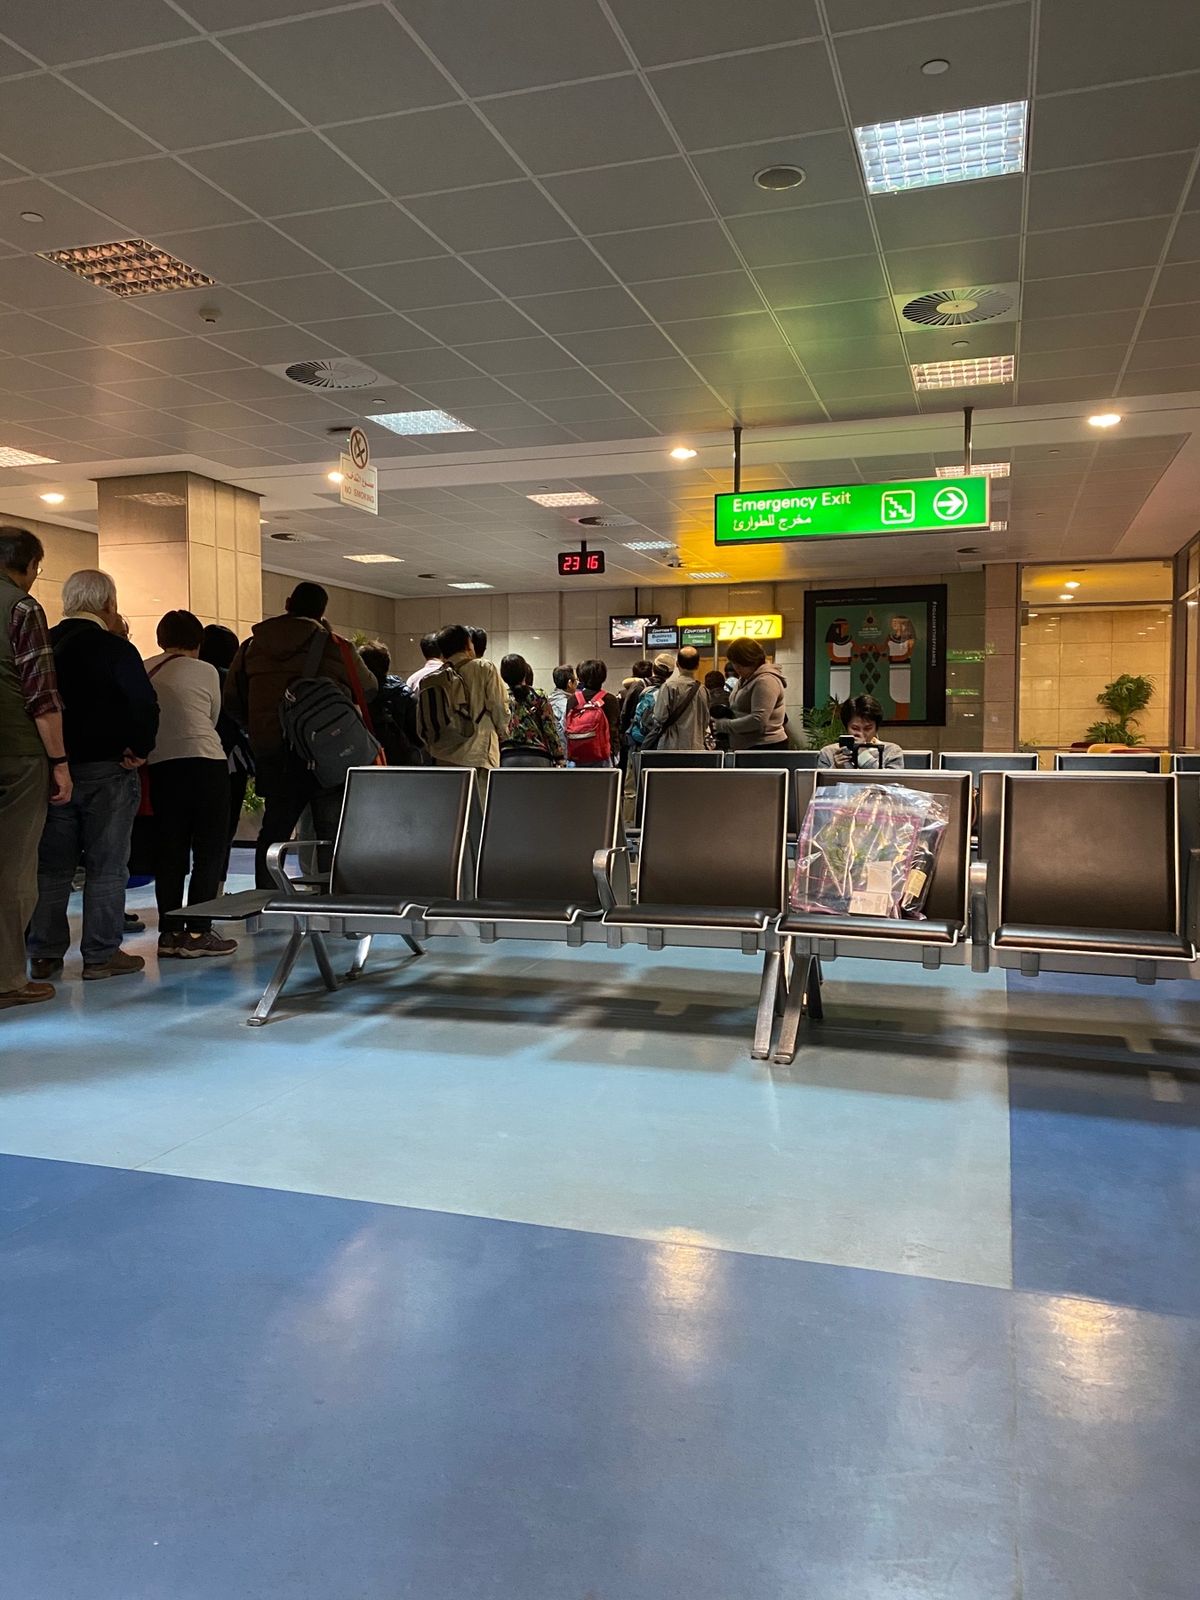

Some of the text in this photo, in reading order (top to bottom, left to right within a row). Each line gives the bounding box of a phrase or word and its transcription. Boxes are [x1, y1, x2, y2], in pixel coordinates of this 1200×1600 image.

[344, 485, 375, 503] NO SMOKING
[733, 491, 851, 512] Emergency Exit
[733, 514, 812, 531] مخرج للطوارئ
[563, 555, 599, 571] 23 16
